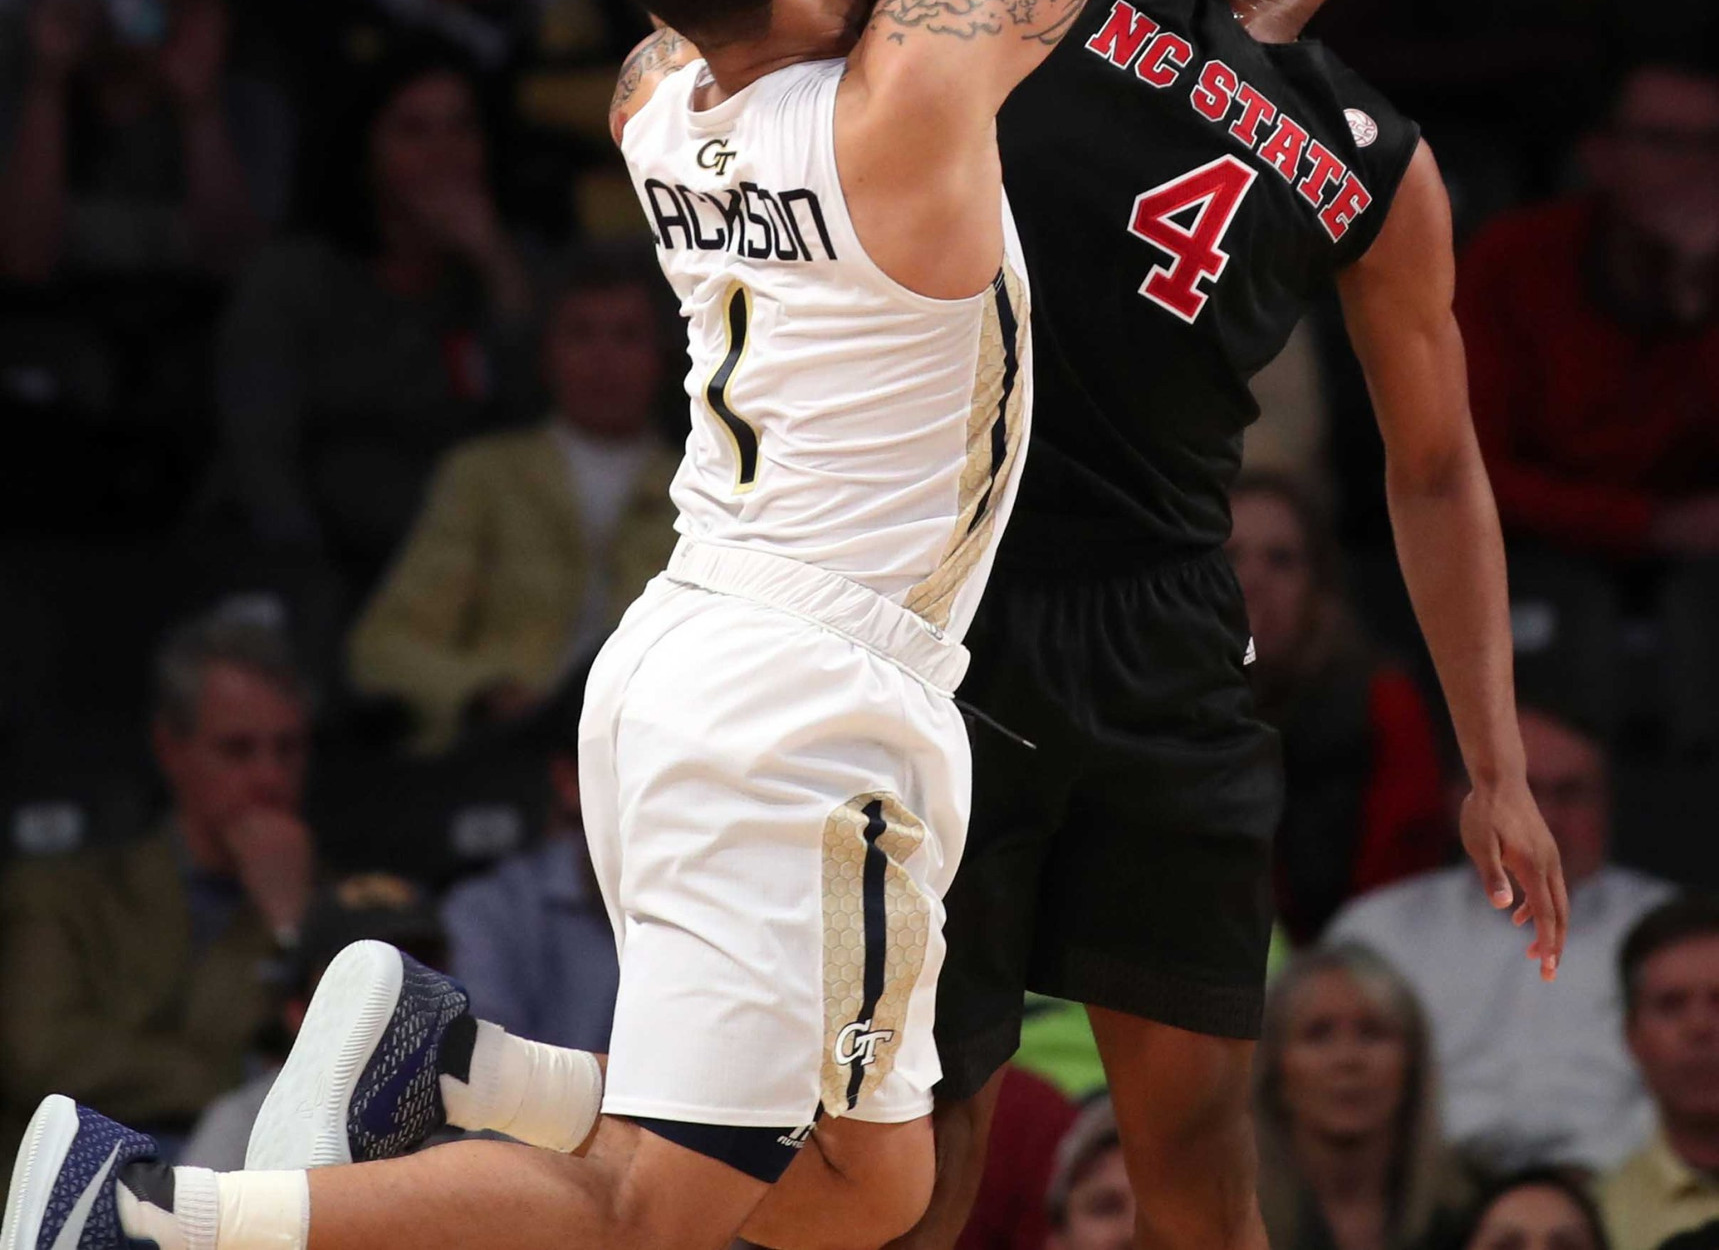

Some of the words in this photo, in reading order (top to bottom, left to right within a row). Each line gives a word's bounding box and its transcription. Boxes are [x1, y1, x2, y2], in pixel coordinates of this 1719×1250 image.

[1085, 0, 1193, 88] NC
[1190, 60, 1372, 243] STATE
[644, 178, 838, 262] ACKSON
[1127, 154, 1258, 324] 4
[703, 279, 762, 495] 1
